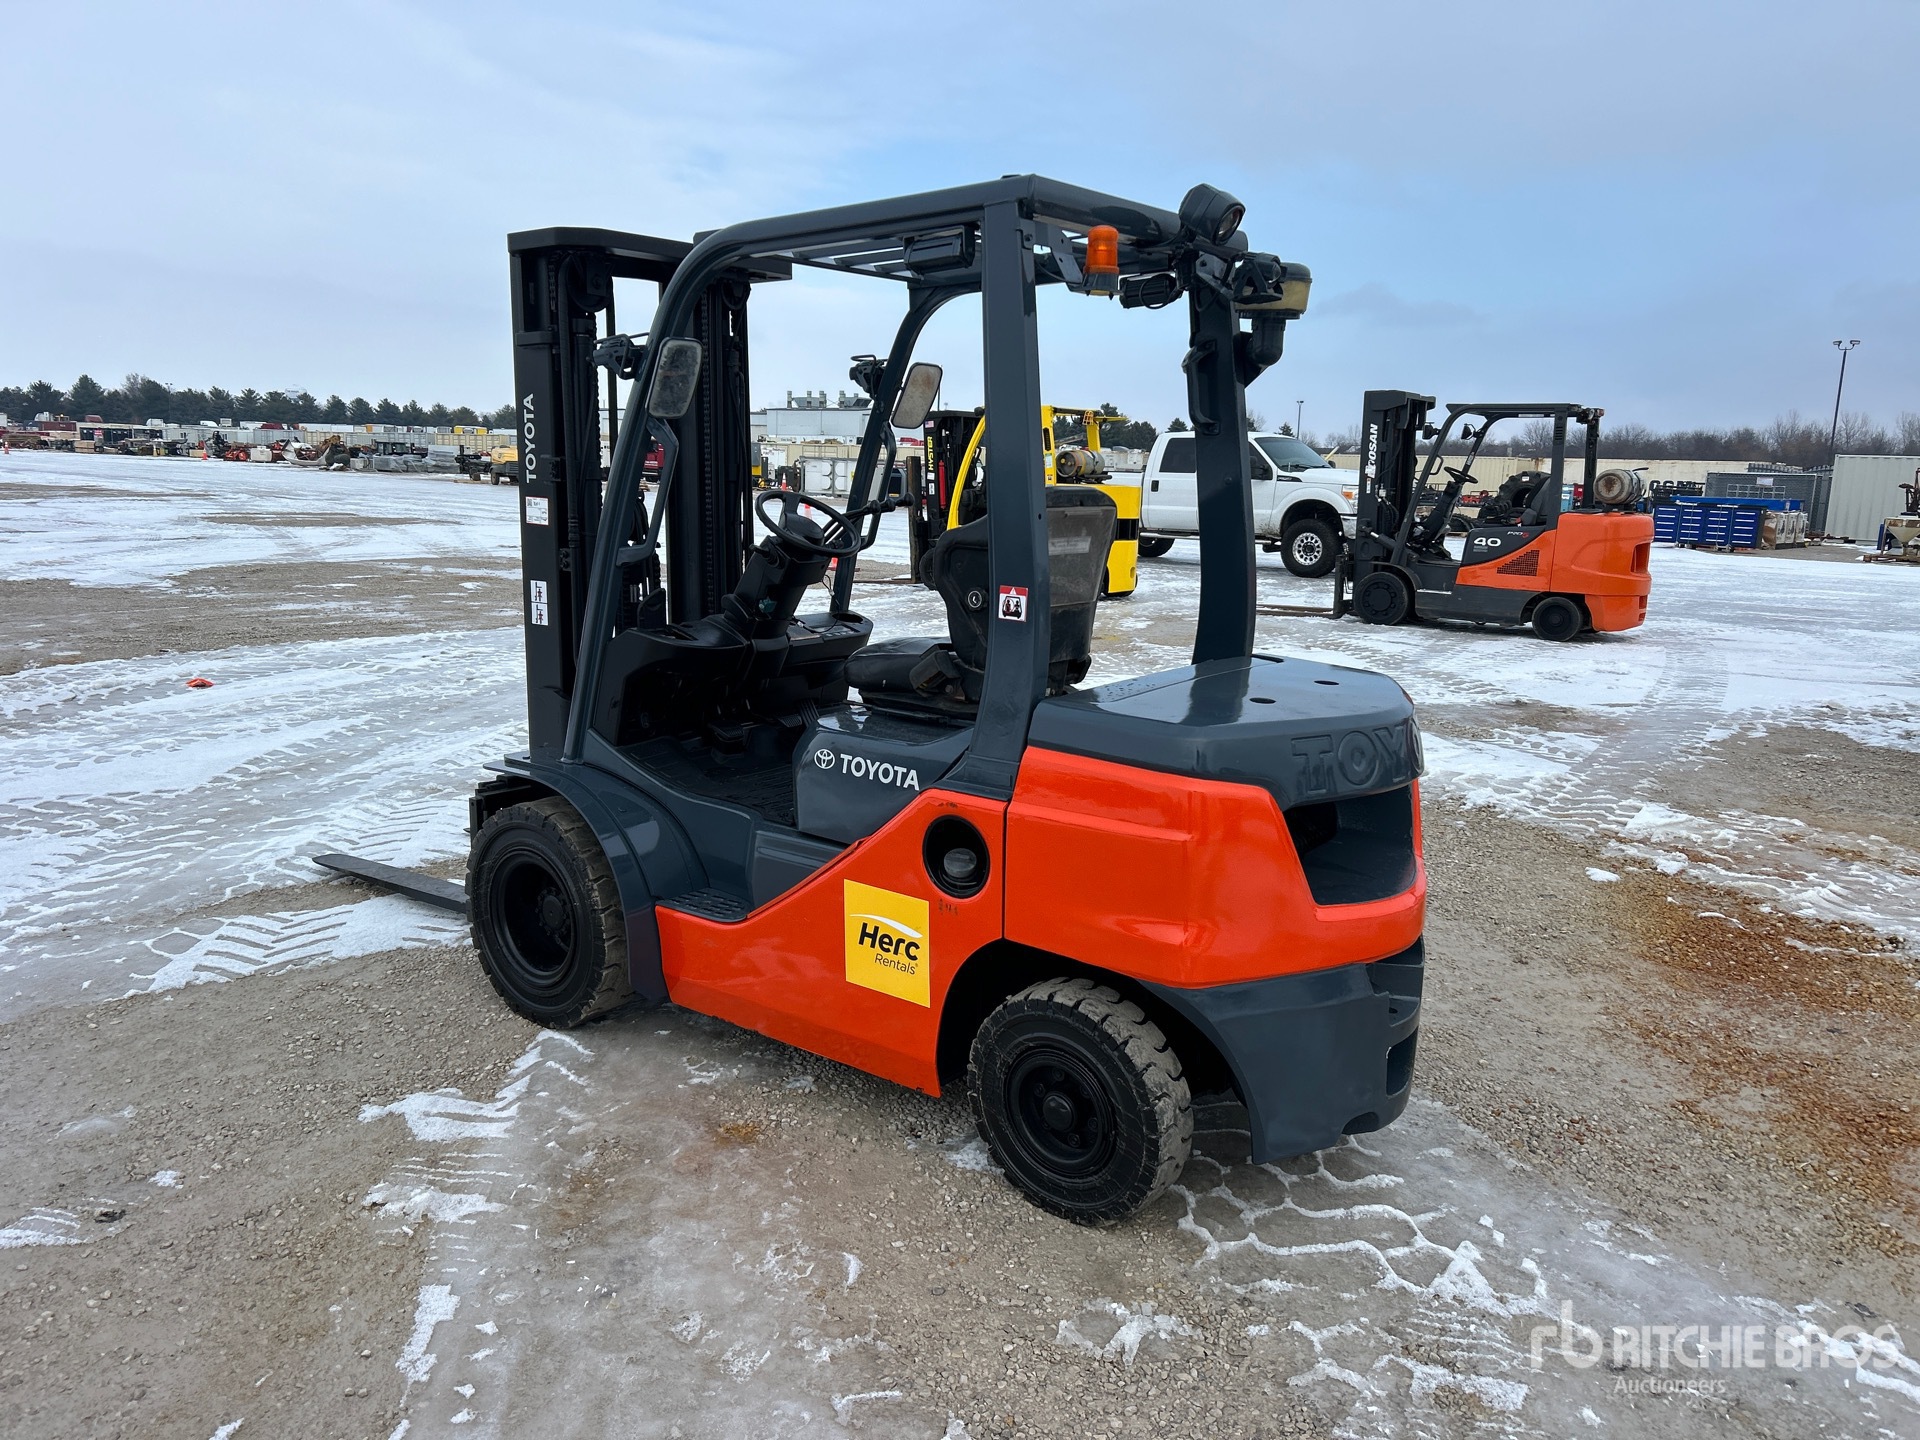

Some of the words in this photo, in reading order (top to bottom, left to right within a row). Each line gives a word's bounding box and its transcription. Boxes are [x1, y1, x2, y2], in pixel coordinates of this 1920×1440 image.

[523, 393, 537, 484] TOYOTA
[1366, 423, 1378, 478] OOSAN
[1473, 537, 1502, 547] 40
[840, 753, 920, 791] TOYOTA
[858, 922, 921, 961] Herc
[874, 953, 917, 975] Rentals
